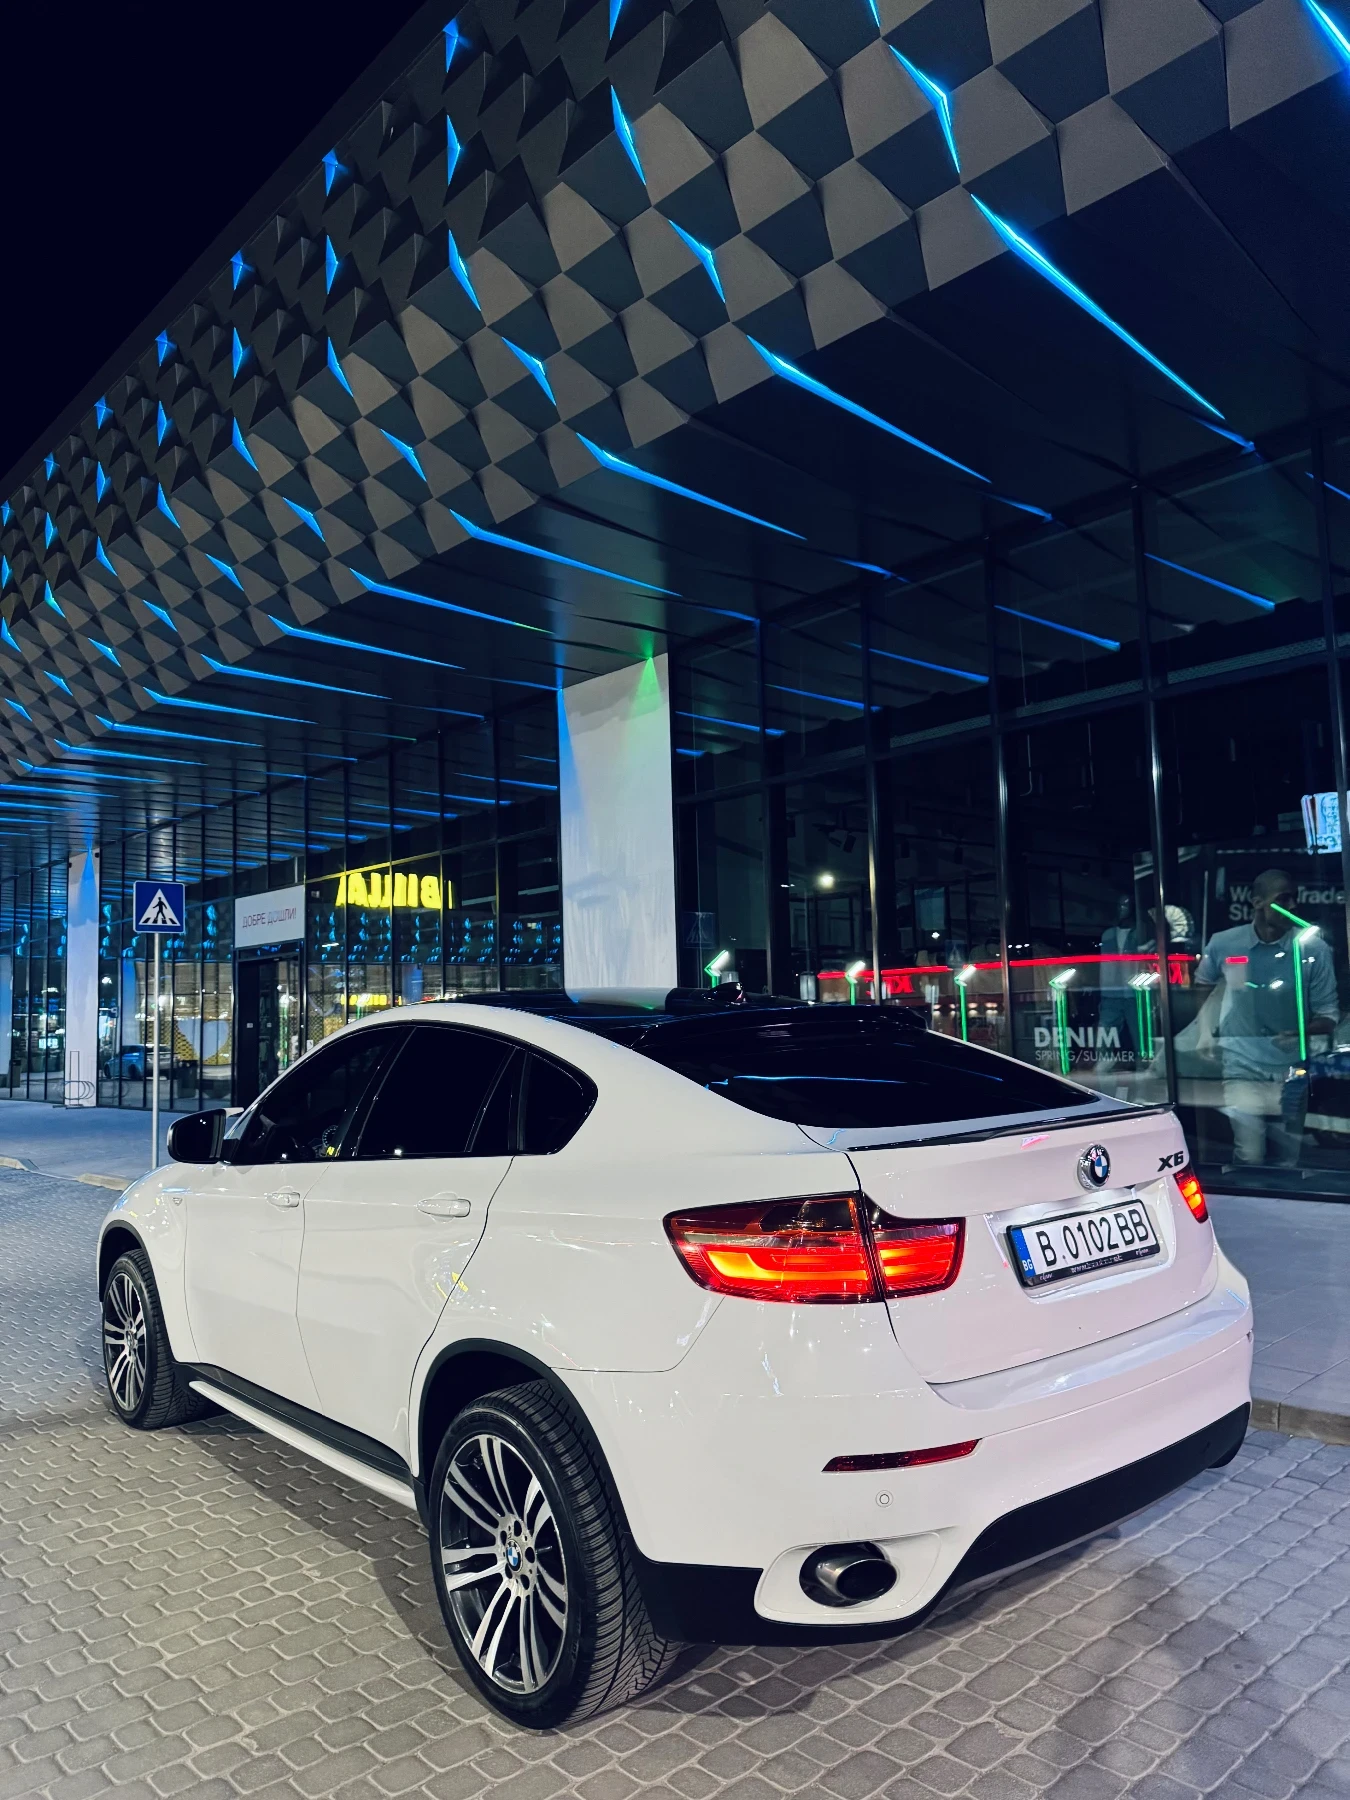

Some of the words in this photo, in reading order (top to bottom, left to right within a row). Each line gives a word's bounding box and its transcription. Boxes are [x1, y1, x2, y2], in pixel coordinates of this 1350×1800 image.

[242, 912, 266, 928] ДОБРЕ
[1033, 1026, 1121, 1048] DENIM
[1157, 1150, 1184, 1172] X6
[1022, 1258, 1034, 1271] BG
